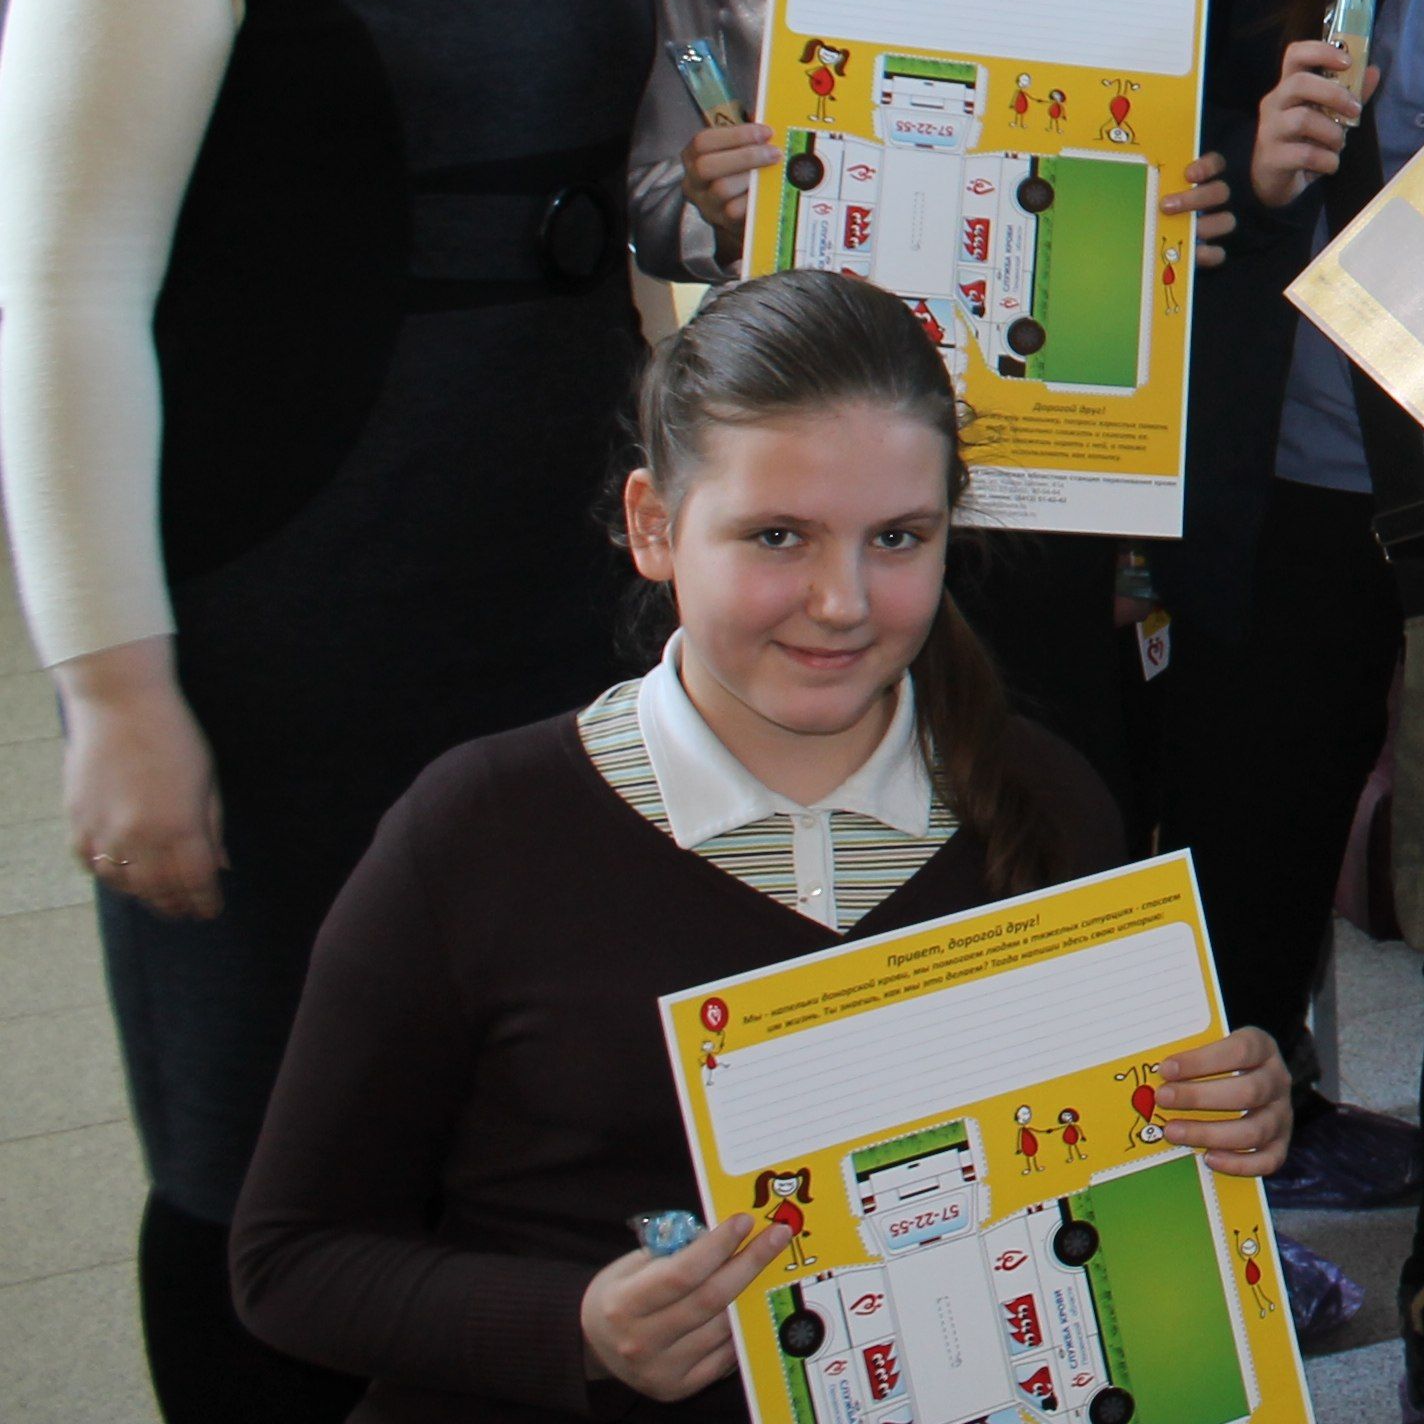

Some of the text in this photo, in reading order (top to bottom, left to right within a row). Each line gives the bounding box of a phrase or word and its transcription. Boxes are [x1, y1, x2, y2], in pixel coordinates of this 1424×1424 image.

[895, 119, 953, 137] 57-22-55
[885, 912, 1042, 970] Привет, дорогой друг!
[888, 1203, 960, 1238] 57-22-55
[1052, 1287, 1079, 1371] СЛУЖБА КРОВИ
